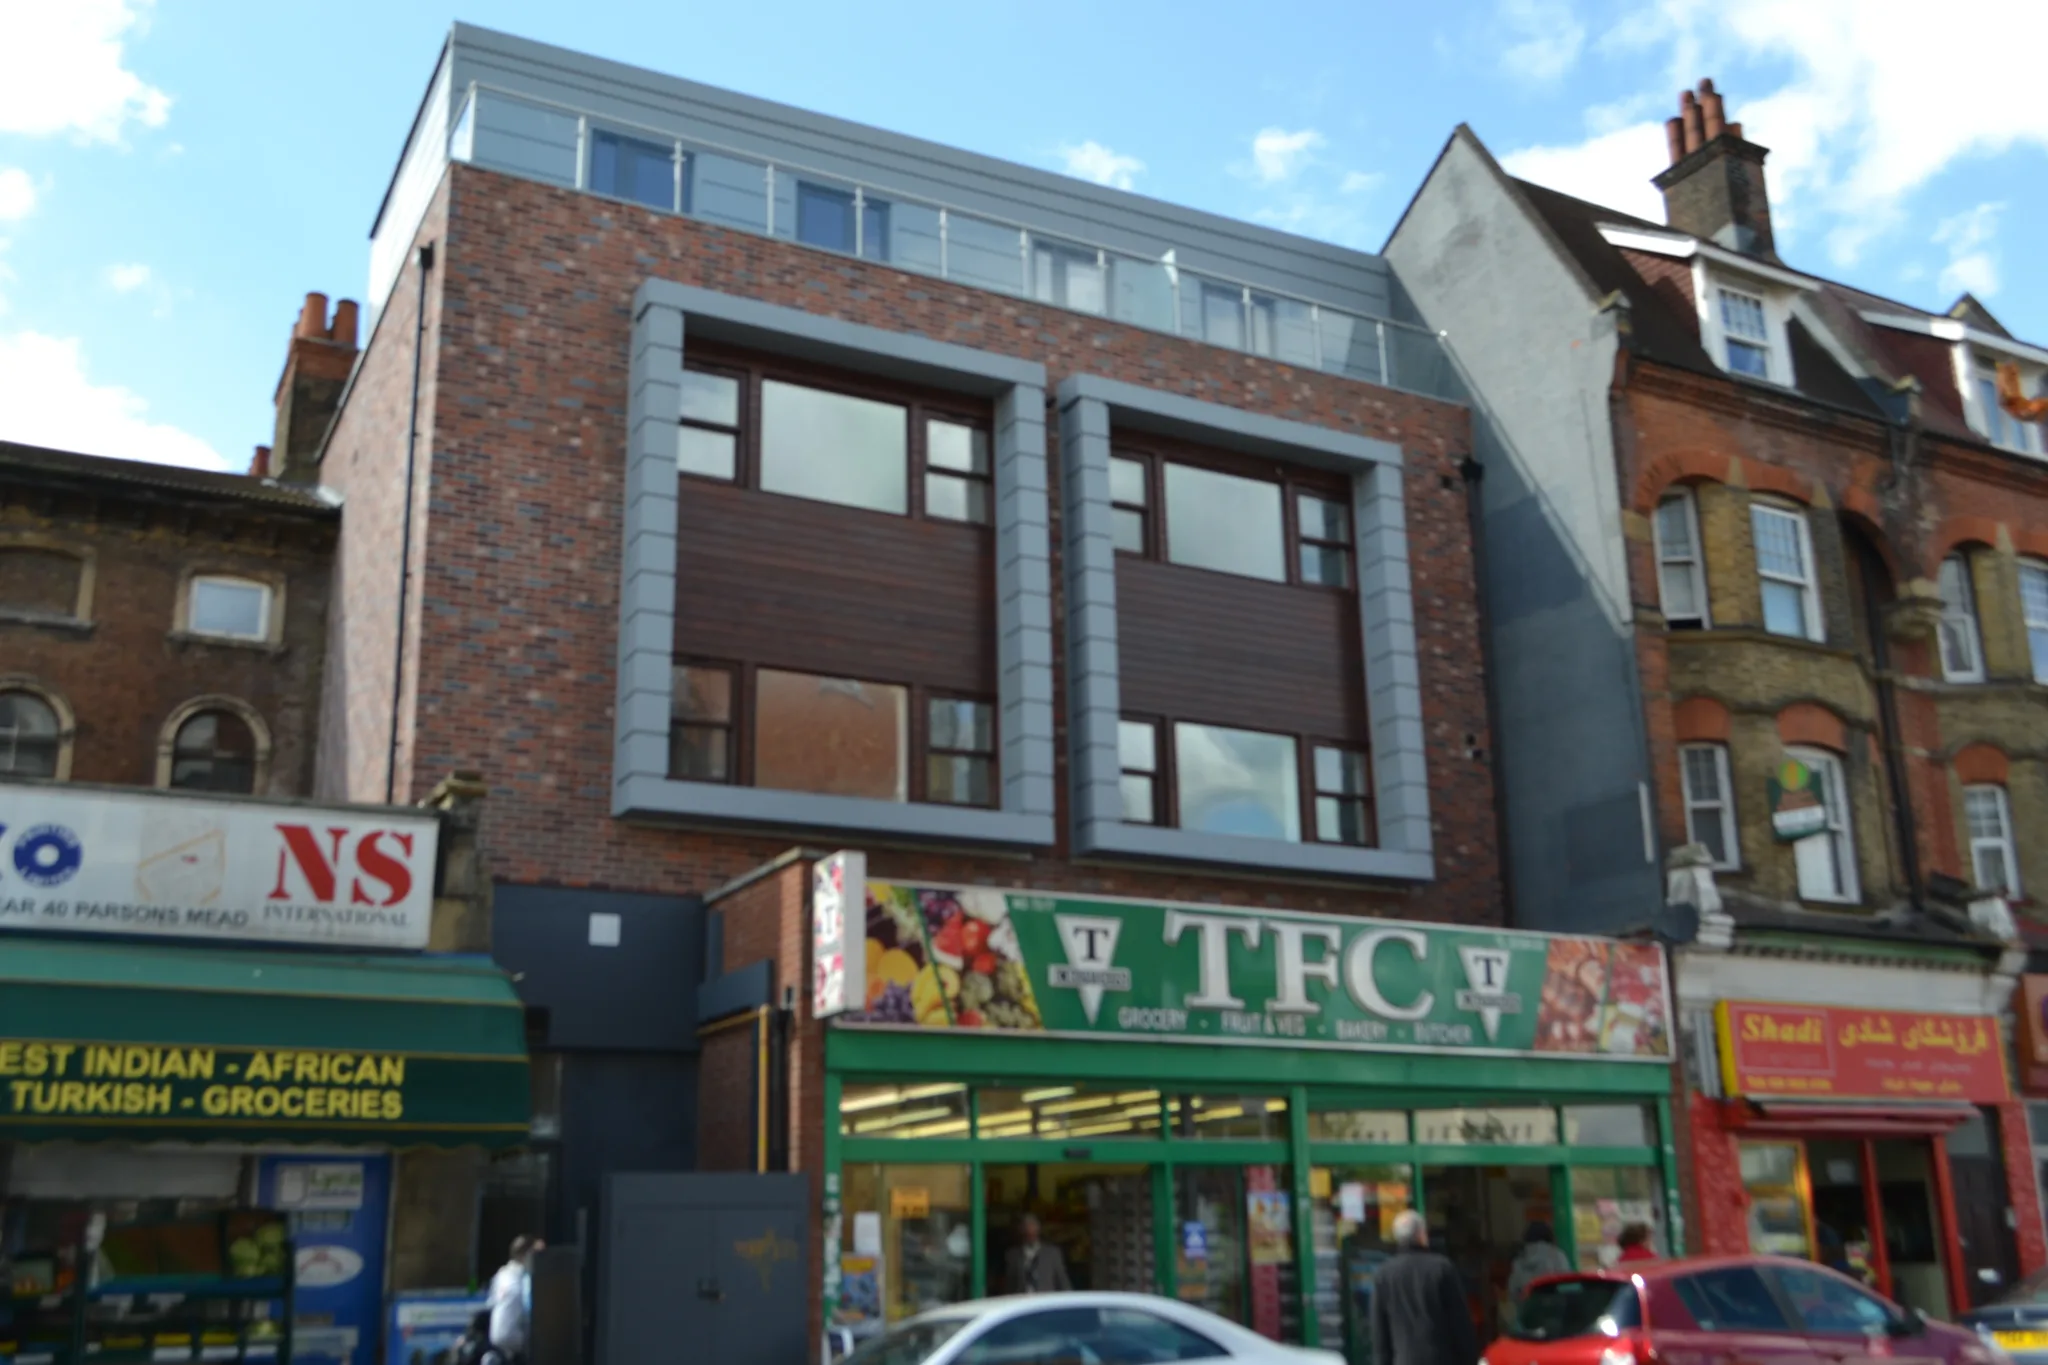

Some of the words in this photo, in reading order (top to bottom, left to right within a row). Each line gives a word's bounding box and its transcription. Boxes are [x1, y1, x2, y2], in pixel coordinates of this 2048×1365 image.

[266, 822, 414, 907] NS
[0, 895, 37, 914] AR
[42, 900, 69, 917] 40
[75, 901, 181, 925] PARSONS
[186, 906, 250, 928] MEAD
[263, 904, 409, 927] INTERNATIONAL
[1073, 926, 1110, 963] T
[1162, 908, 1436, 1022] TFC
[1473, 955, 1504, 987] T
[1118, 1006, 1188, 1031] GROCERY
[1741, 1013, 1823, 1045] Shadi
[83, 1044, 217, 1080] INDIAN
[245, 1050, 406, 1086] AFRICAN
[10, 1080, 173, 1115] TURKISH
[202, 1084, 404, 1120] GROCERIES
